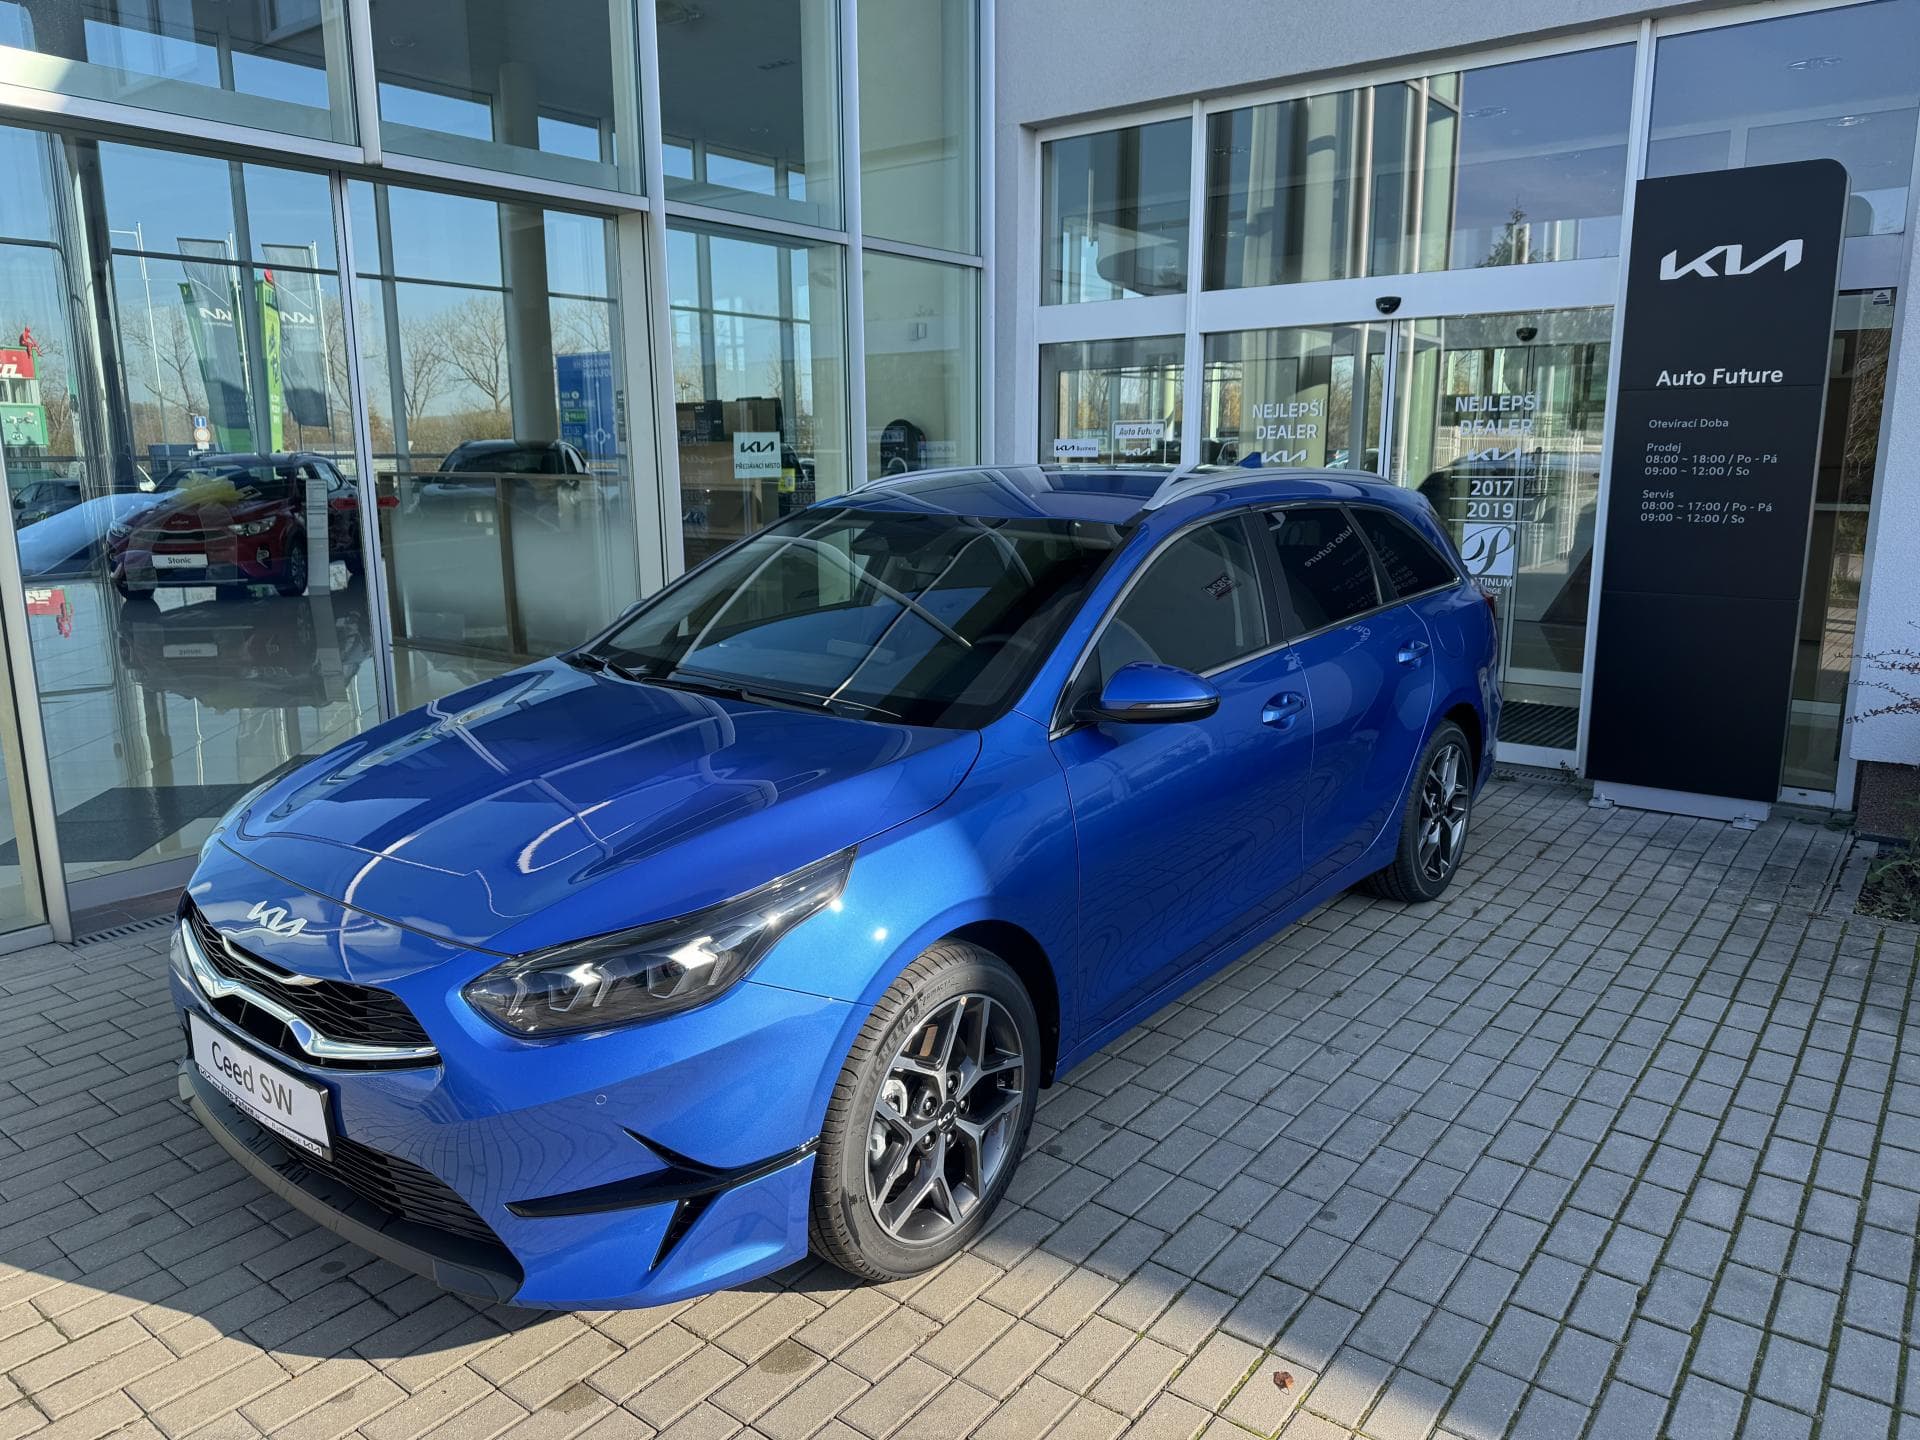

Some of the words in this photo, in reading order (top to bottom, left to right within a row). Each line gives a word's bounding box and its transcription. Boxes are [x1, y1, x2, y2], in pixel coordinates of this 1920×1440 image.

[1660, 239, 1803, 281] KIA
[1656, 370, 1706, 387] Auto
[1713, 368, 1784, 385] Future
[1252, 398, 1324, 419] NEJLEPŠÍ
[1460, 419, 1533, 436] DEALER
[1700, 418, 1729, 428] Doba
[1118, 427, 1136, 436] Auto
[1256, 424, 1317, 440] DEALER
[741, 440, 775, 453] KIA
[1646, 442, 1682, 454] Prodej
[1261, 448, 1307, 464] KIA
[1467, 447, 1523, 461] KIA
[1645, 454, 1679, 464] 08:00
[1692, 454, 1726, 464] 18:00
[1737, 454, 1752, 464] Po
[1762, 454, 1777, 464] Pá
[1644, 466, 1678, 476] 09:00
[1691, 466, 1725, 476] 12:00
[1735, 466, 1750, 476] So
[1470, 480, 1514, 496] 2017
[1642, 489, 1675, 499] Servis
[1466, 502, 1515, 519] 2019
[1641, 501, 1675, 511] 08:00
[1687, 502, 1721, 511] 17:00
[1732, 502, 1747, 512] Po
[1757, 502, 1773, 512] Pá
[1640, 513, 1674, 523] 09:00
[1686, 514, 1720, 523] 12:00
[1730, 514, 1746, 524] So
[167, 556, 192, 565] Stonic
[246, 900, 308, 937] KIA
[211, 1041, 255, 1095] Ceed
[259, 1072, 292, 1116] SW
